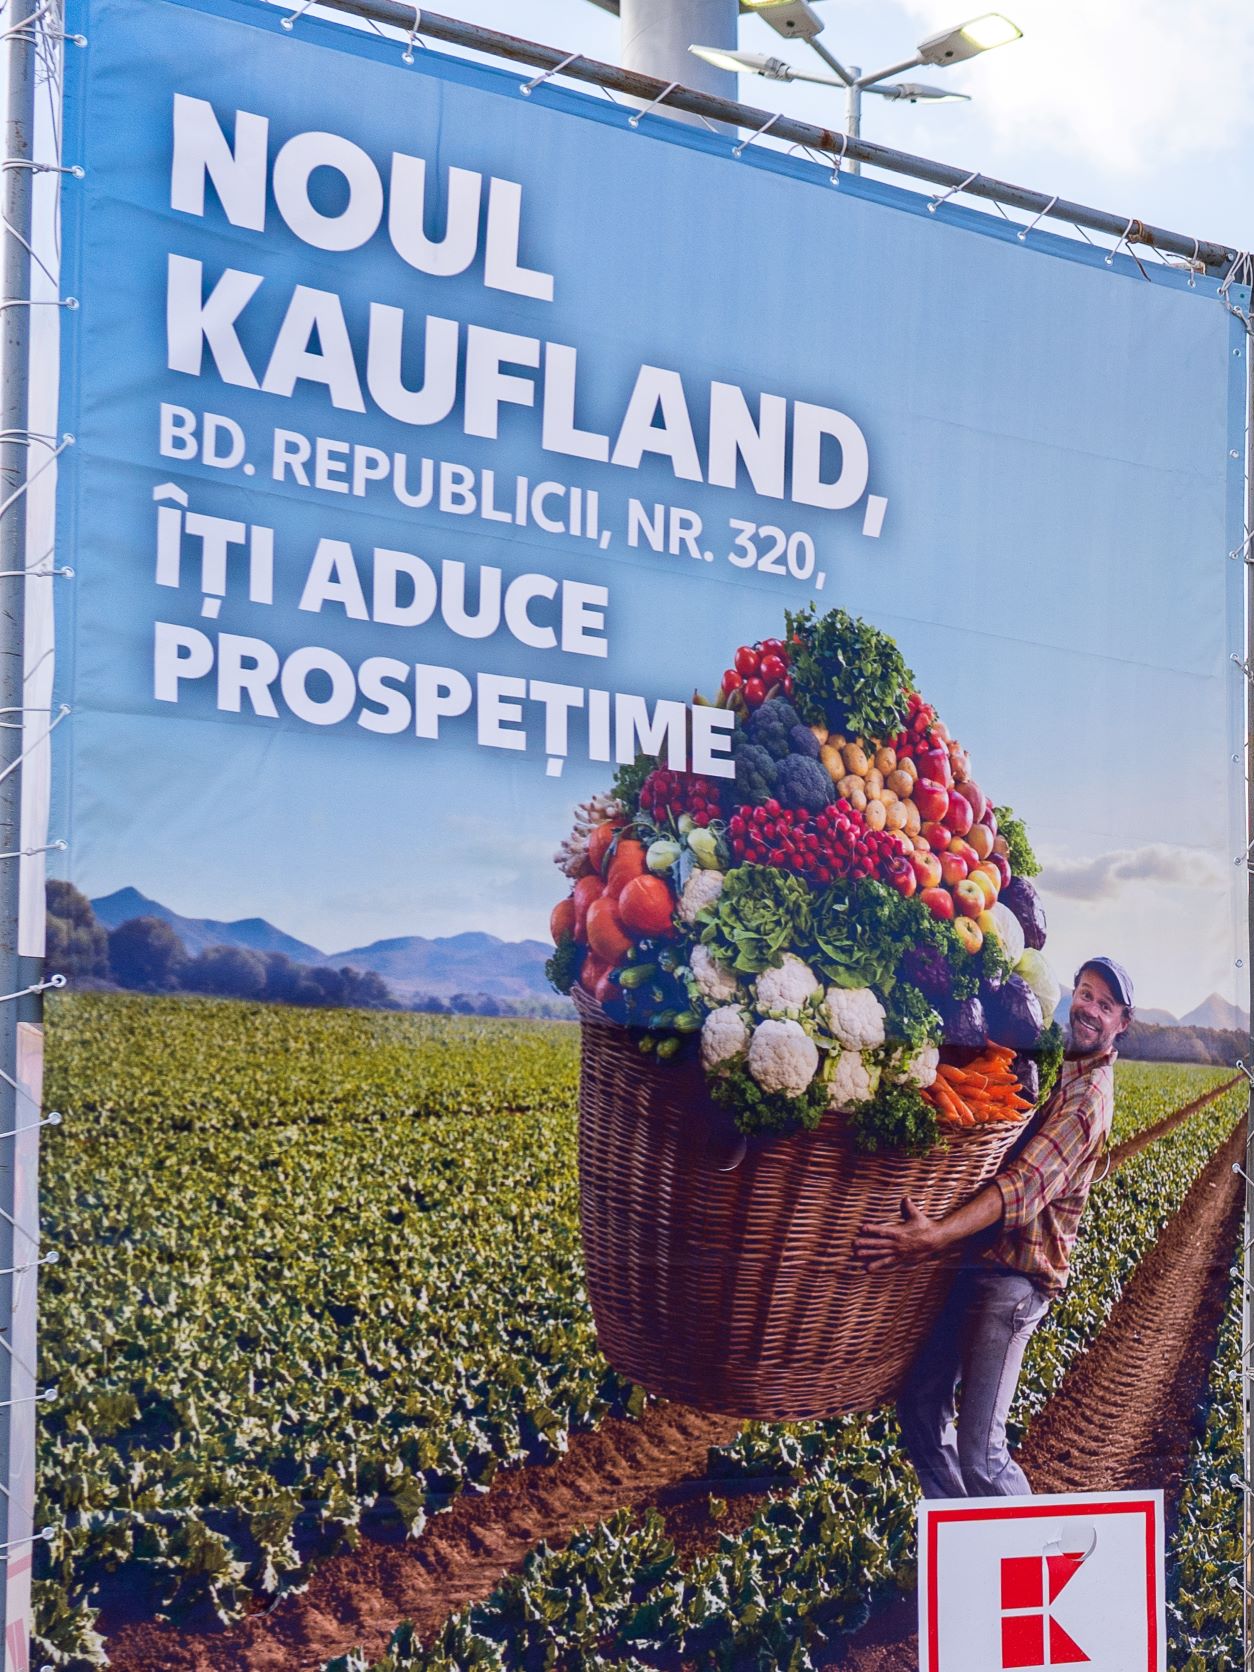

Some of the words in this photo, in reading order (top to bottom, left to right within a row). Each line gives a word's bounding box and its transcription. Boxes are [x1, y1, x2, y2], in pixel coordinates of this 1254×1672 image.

[171, 93, 554, 302] NOUL
[167, 252, 888, 538] KAUFLAND,
[152, 482, 274, 620] ÎȚI
[298, 538, 609, 658] ADUCE
[159, 402, 255, 476] BD.
[272, 428, 611, 550] REPUBLICII,
[626, 497, 713, 562] NR.
[727, 518, 827, 589] 320,
[152, 621, 736, 779] PROSPEȚIME
